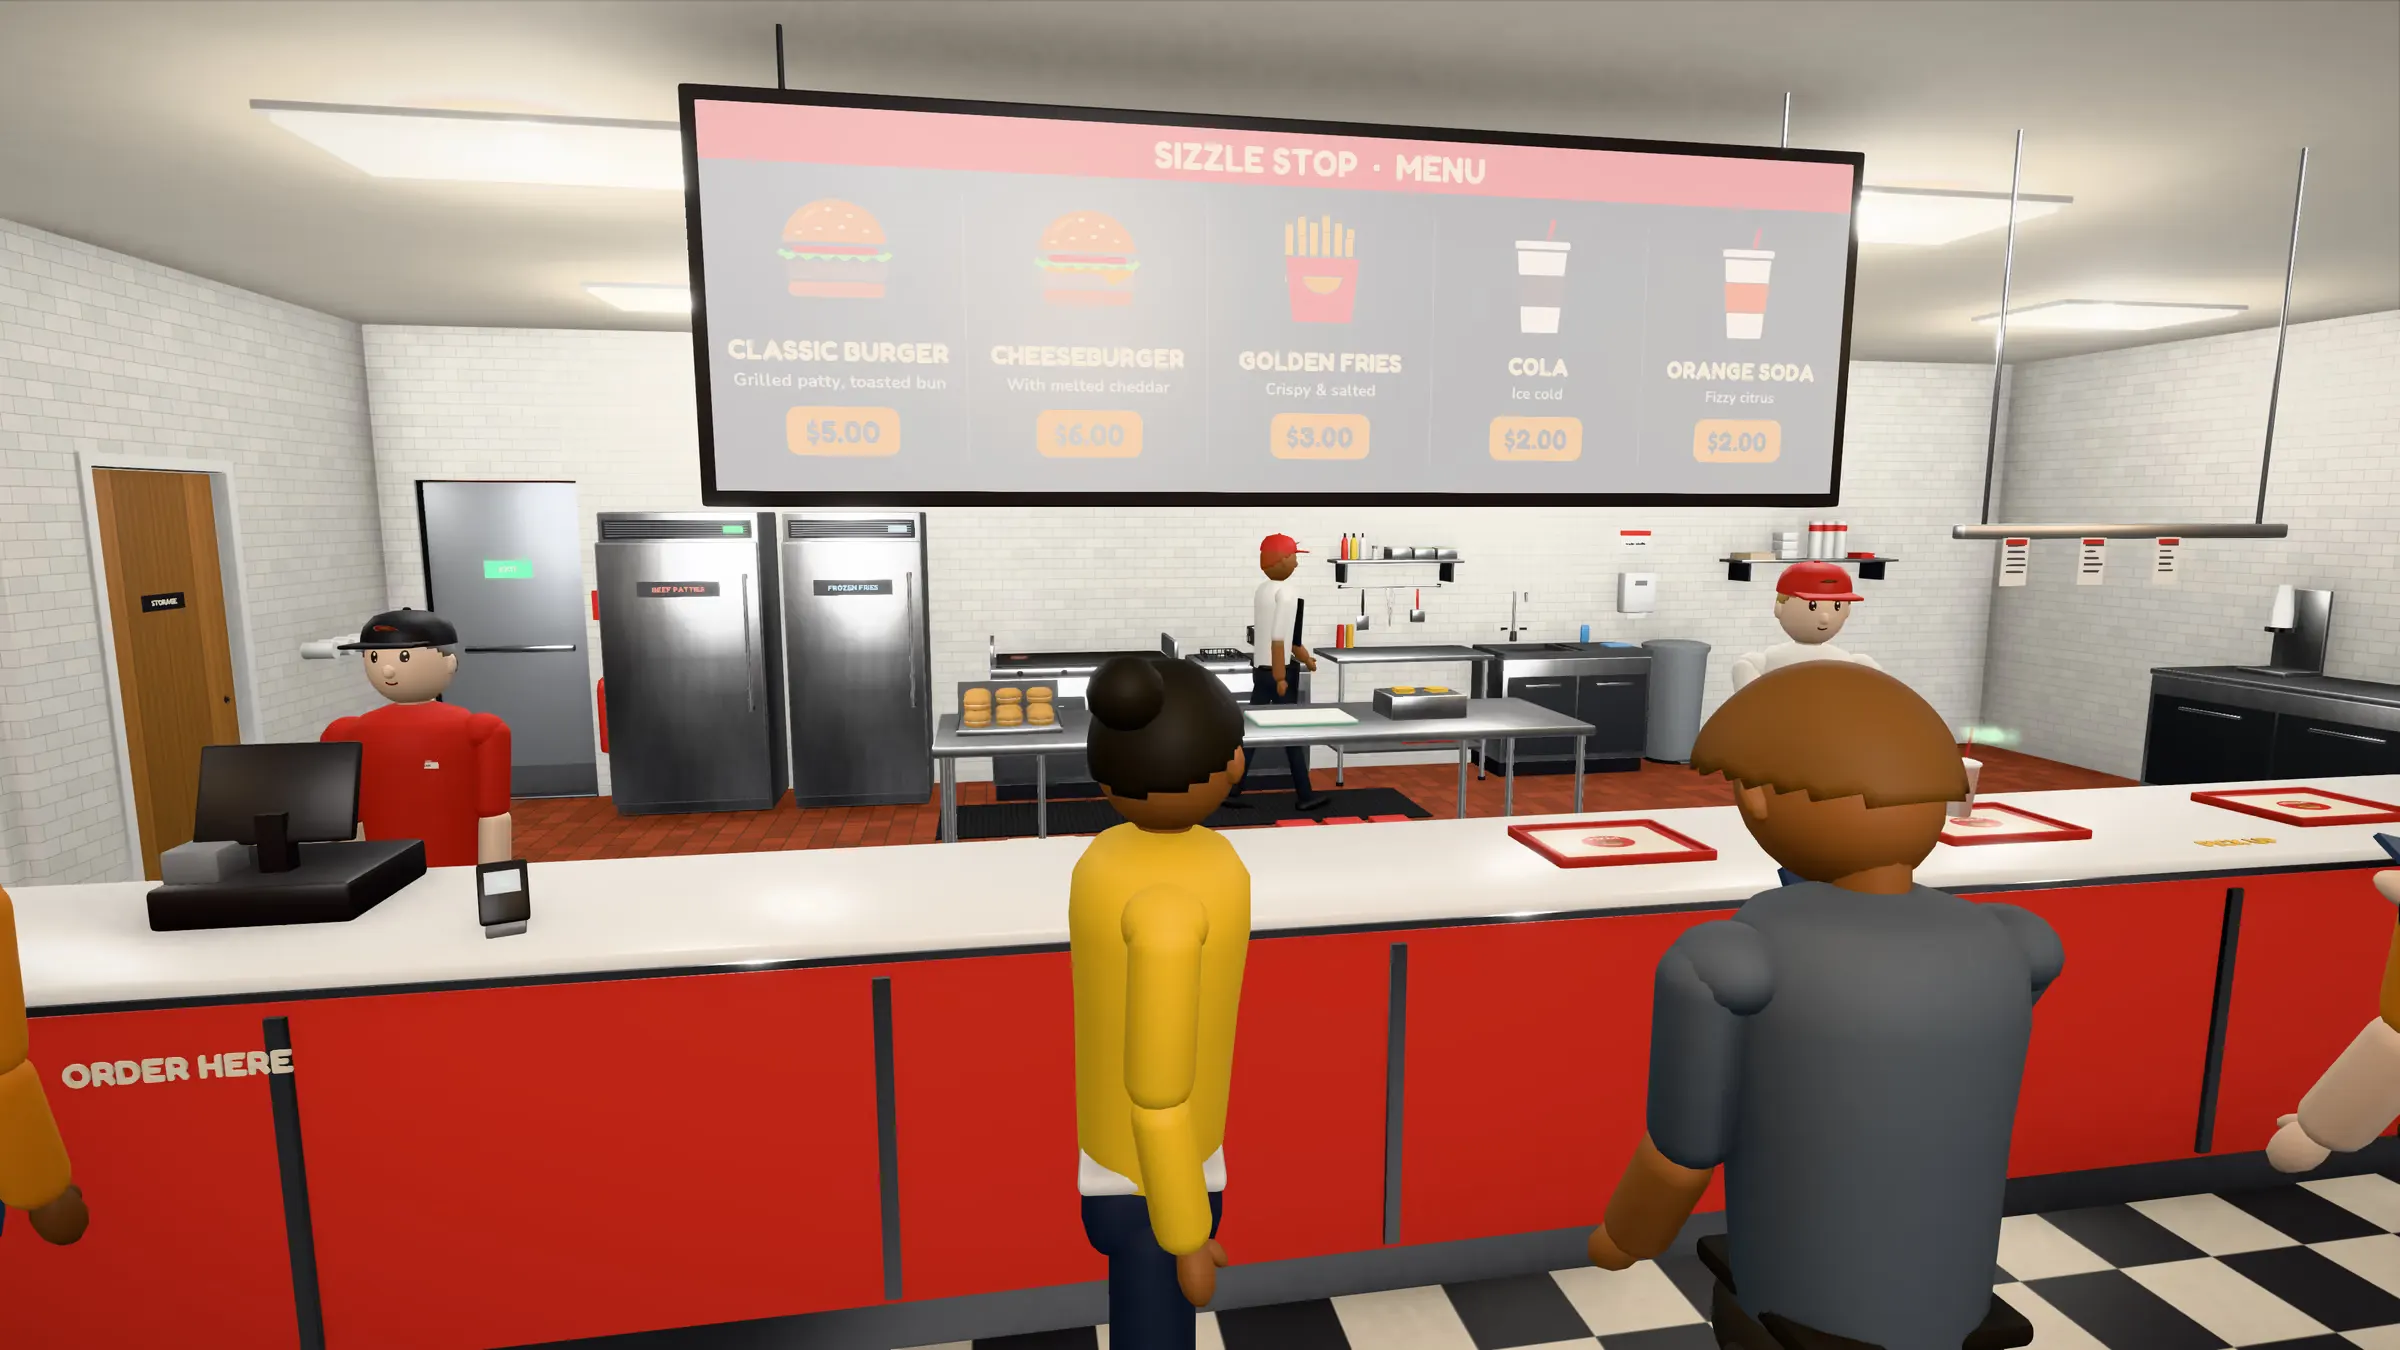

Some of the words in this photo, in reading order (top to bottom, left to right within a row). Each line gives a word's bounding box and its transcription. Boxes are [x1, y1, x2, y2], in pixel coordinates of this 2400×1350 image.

[1154, 140, 1264, 173] SIZZLE
[1272, 147, 1358, 178] STOP
[1395, 154, 1486, 185] MENU
[727, 338, 838, 362] CLASSIC
[843, 341, 950, 364] BURGER
[990, 345, 1185, 369] CHEESEBURGER
[1238, 350, 1335, 372] GOLDEN
[1340, 353, 1403, 374] FRIES
[1508, 357, 1569, 378] COLA
[1666, 360, 1755, 381] ORANGE
[1758, 363, 1814, 383] SODA
[733, 372, 792, 388] Grilled
[797, 376, 846, 391] patty,
[850, 375, 911, 390] toasted
[916, 375, 947, 390] bun
[1006, 377, 1046, 392] With
[1050, 379, 1104, 393] melted
[1109, 380, 1171, 394] cheddar
[1265, 382, 1311, 399] Crispy
[1315, 383, 1327, 396] &
[1331, 384, 1376, 397] salted
[1512, 386, 1531, 400] Ice
[1534, 387, 1563, 401] cold
[1705, 390, 1736, 405] Fizzy
[1739, 391, 1775, 404] citrus
[806, 419, 881, 446] $5.00
[1054, 422, 1125, 448] $6.00
[1286, 425, 1353, 450] $3.00
[1504, 427, 1567, 453] $2.00
[1707, 430, 1767, 455] $2.00
[61, 1056, 190, 1090] ORDER
[197, 1048, 294, 1080] HERE
